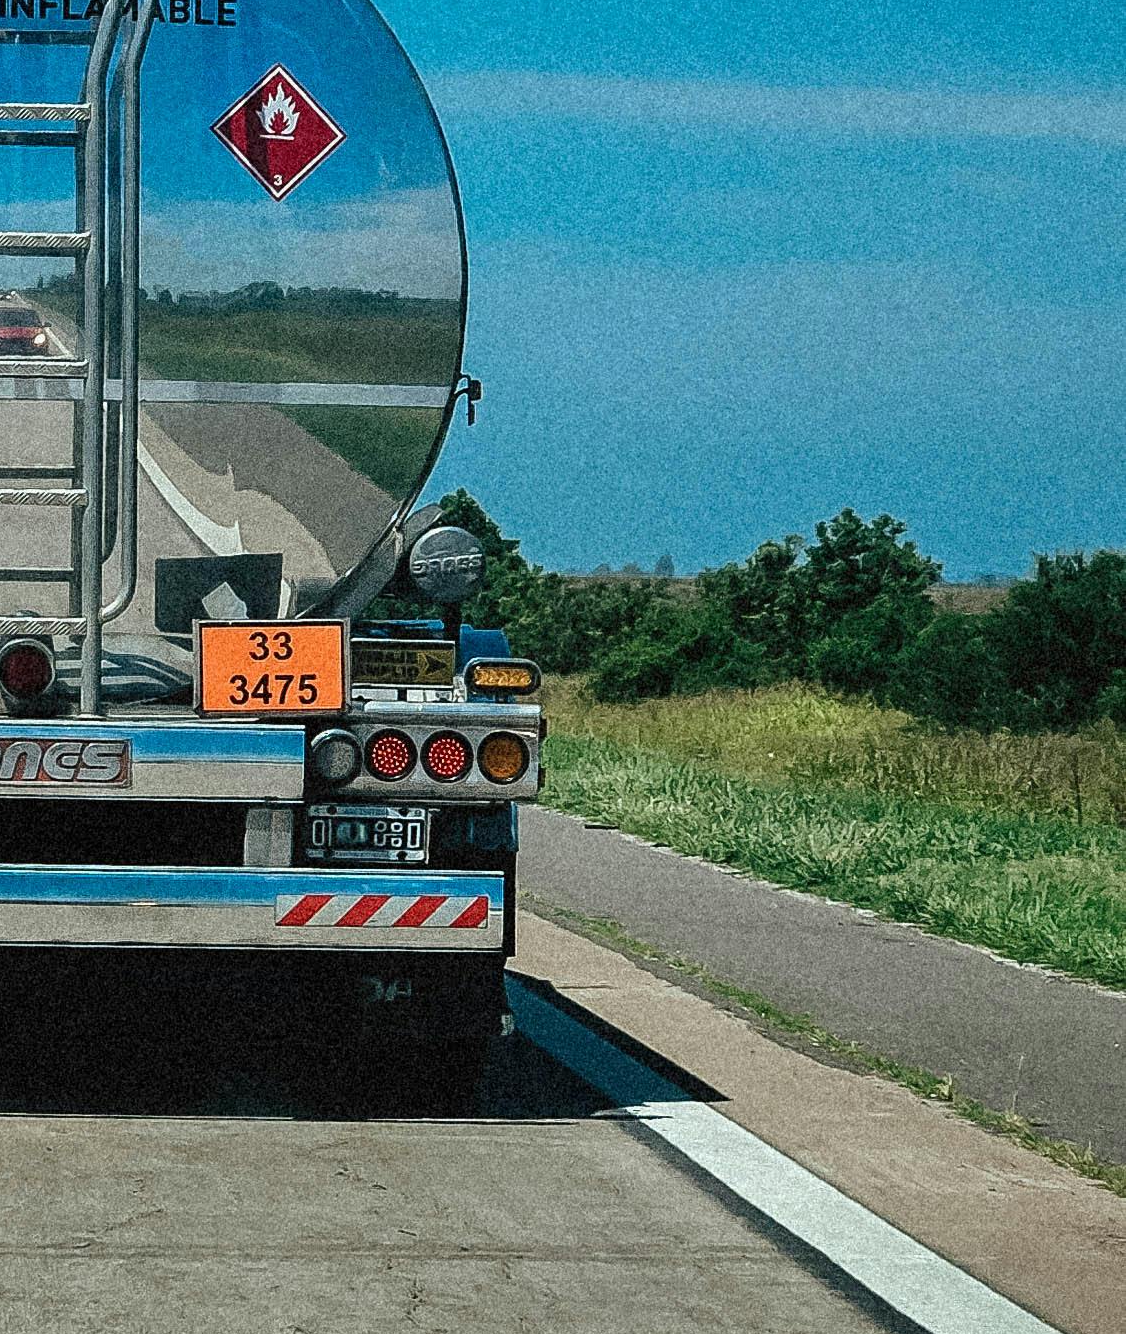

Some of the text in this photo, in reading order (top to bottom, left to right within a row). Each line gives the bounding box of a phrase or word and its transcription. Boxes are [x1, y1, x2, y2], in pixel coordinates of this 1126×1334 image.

[273, 174, 283, 186] 3
[248, 631, 294, 661] 33
[228, 673, 318, 705] 3475
